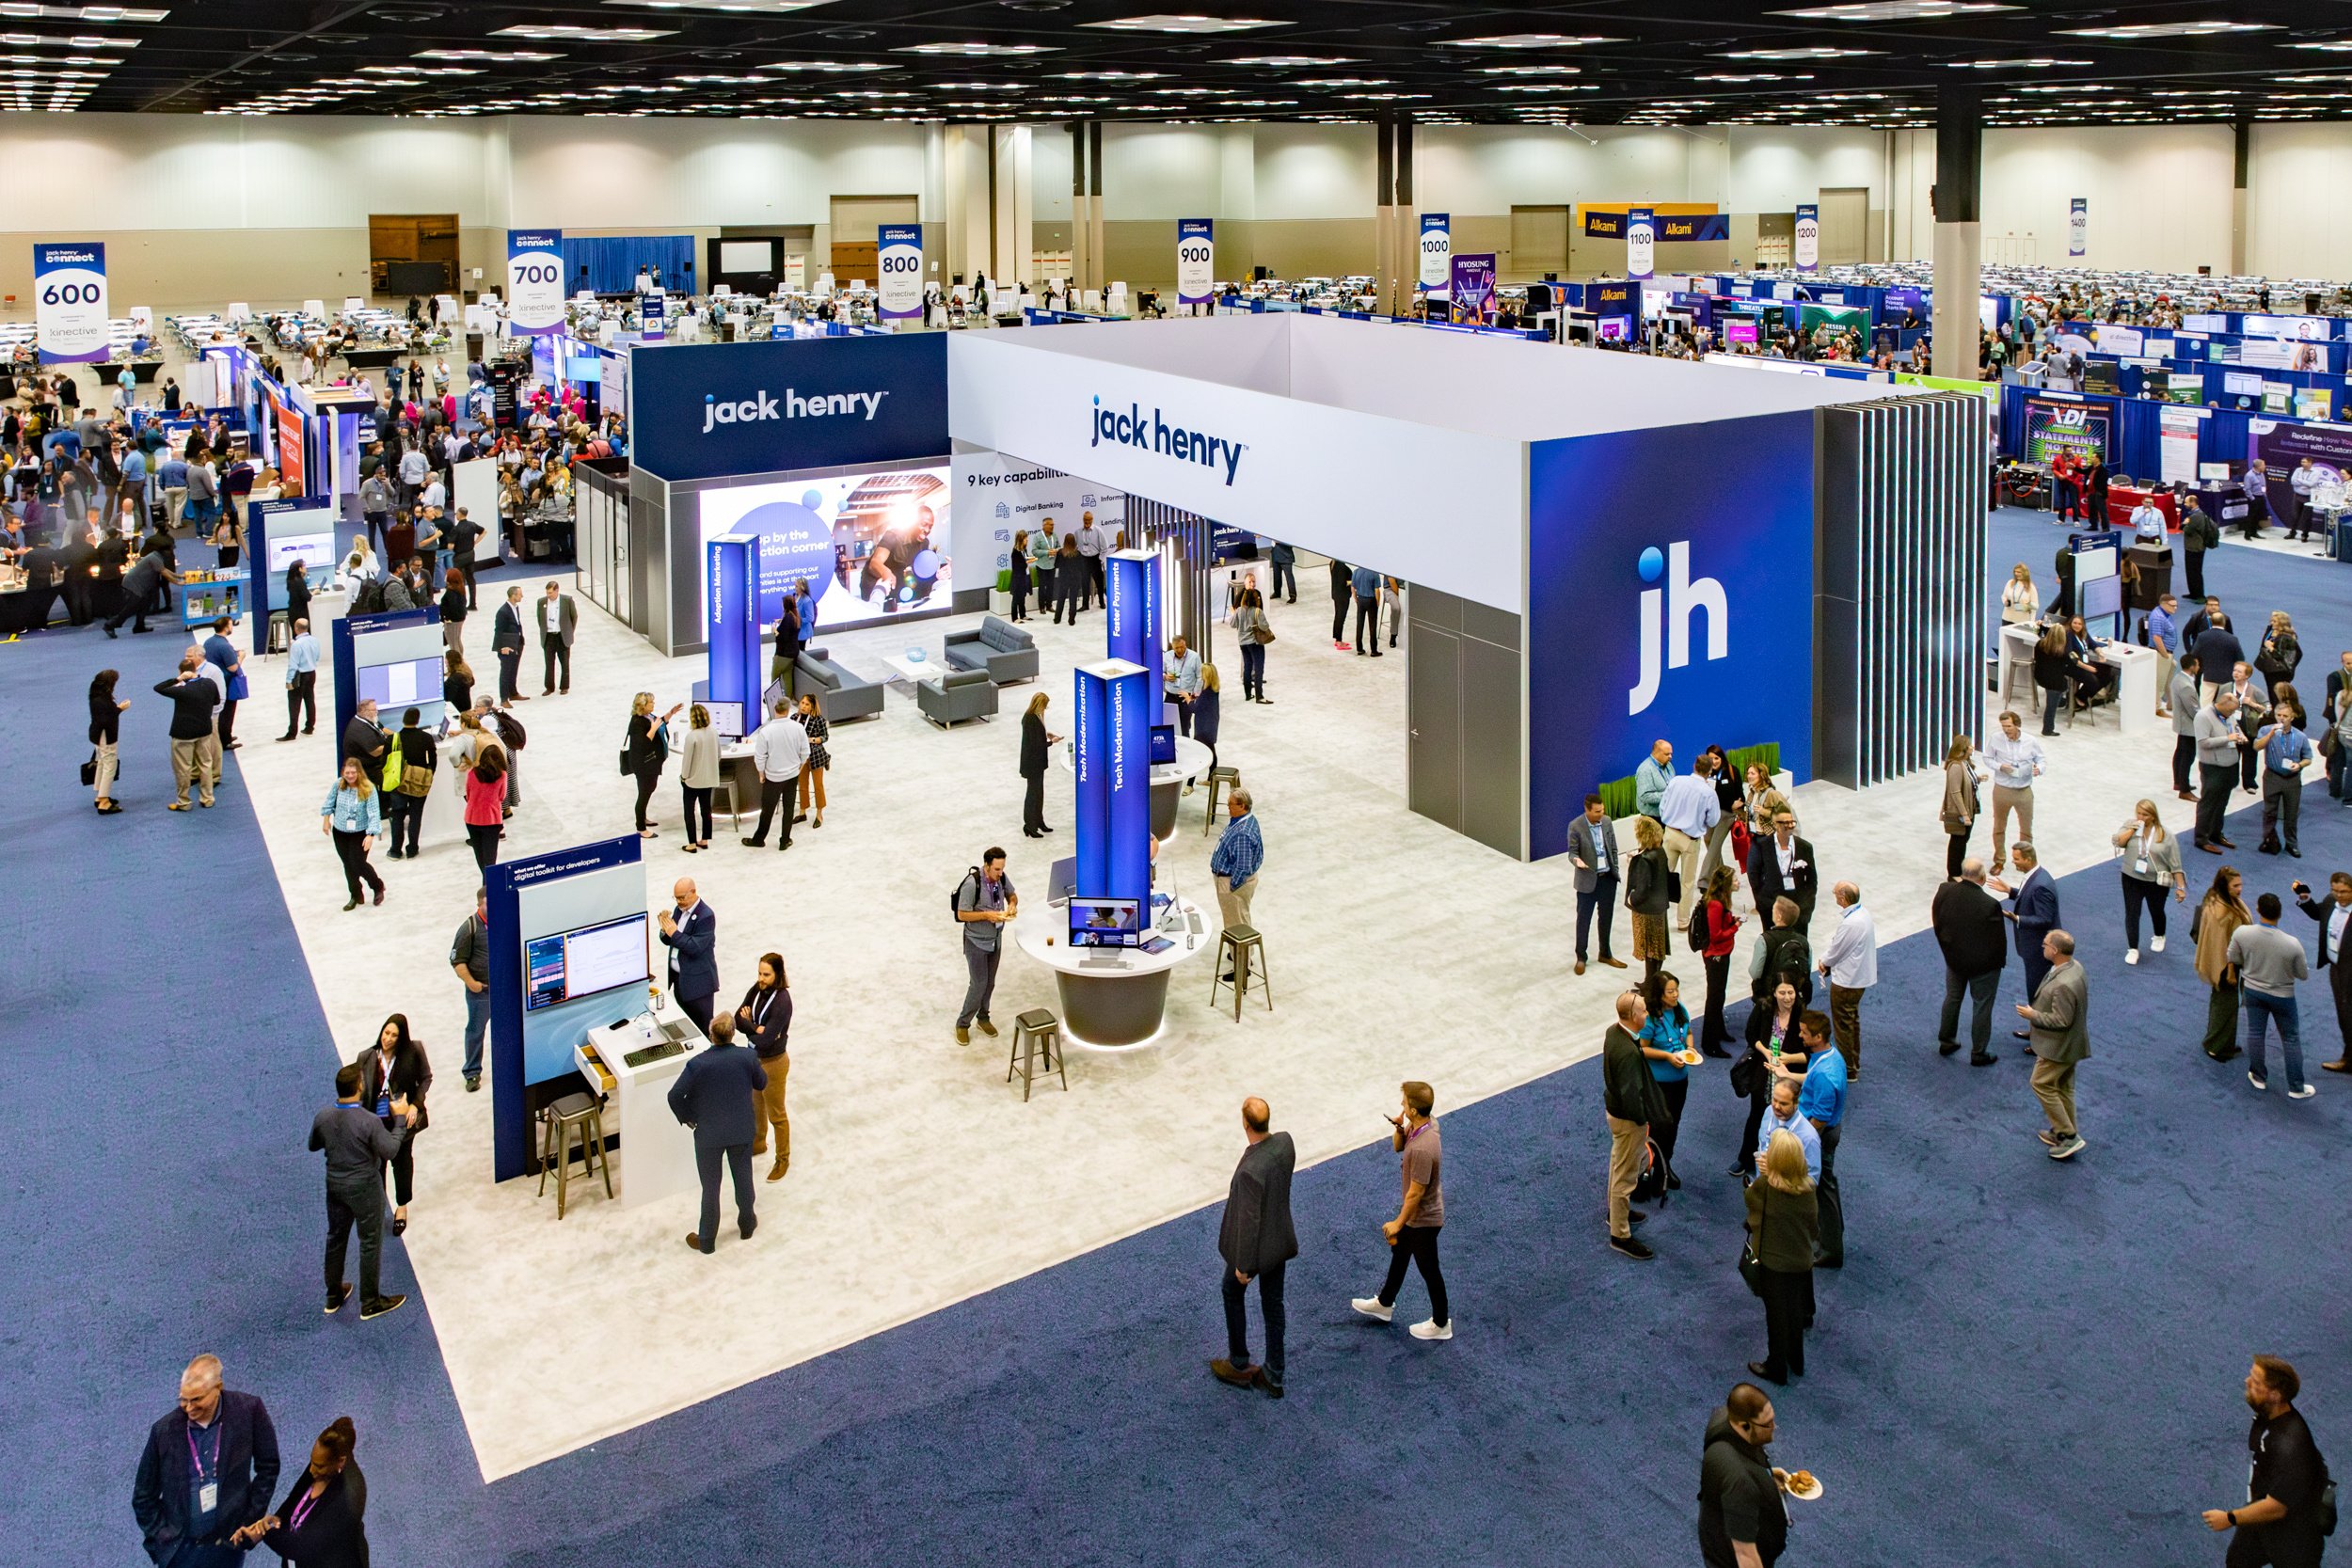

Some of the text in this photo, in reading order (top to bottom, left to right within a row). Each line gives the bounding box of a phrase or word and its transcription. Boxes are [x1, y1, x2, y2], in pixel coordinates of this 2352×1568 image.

[1590, 218, 1617, 233] Alkami
[1666, 222, 1692, 235] Alkami
[885, 232, 916, 240] connect
[1630, 233, 1651, 245] 1100
[1798, 228, 1817, 238] 1200
[516, 238, 554, 247] connect
[1422, 240, 1448, 253] 1000
[46, 253, 95, 263] connect
[1181, 247, 1210, 263] 900
[883, 256, 919, 273] 800
[1458, 260, 1489, 269] HYOSUNG
[514, 265, 558, 285] 700
[43, 283, 101, 305] 600
[1600, 288, 1627, 301] Alkami
[519, 303, 556, 312] kinective
[50, 326, 98, 337] kinective
[703, 394, 779, 433] jack
[1092, 394, 1148, 450] jack
[2033, 430, 2101, 446] STATEMENTS
[2291, 432, 2323, 442] Redefine
[968, 475, 976, 487] 9
[978, 474, 1001, 487] key
[1016, 501, 1063, 513] Digital Banking
[773, 532, 787, 543] by
[789, 530, 808, 540] the
[792, 542, 829, 553] corner
[773, 567, 807, 576] supporting
[714, 546, 723, 624] Adoption Marketing
[1113, 562, 1121, 607] Payments
[1629, 541, 1728, 716] jh
[1114, 682, 1123, 792] Tech Modernization
[514, 871, 535, 881] digital
[536, 867, 555, 876] toolkit
[566, 857, 600, 869] developers
